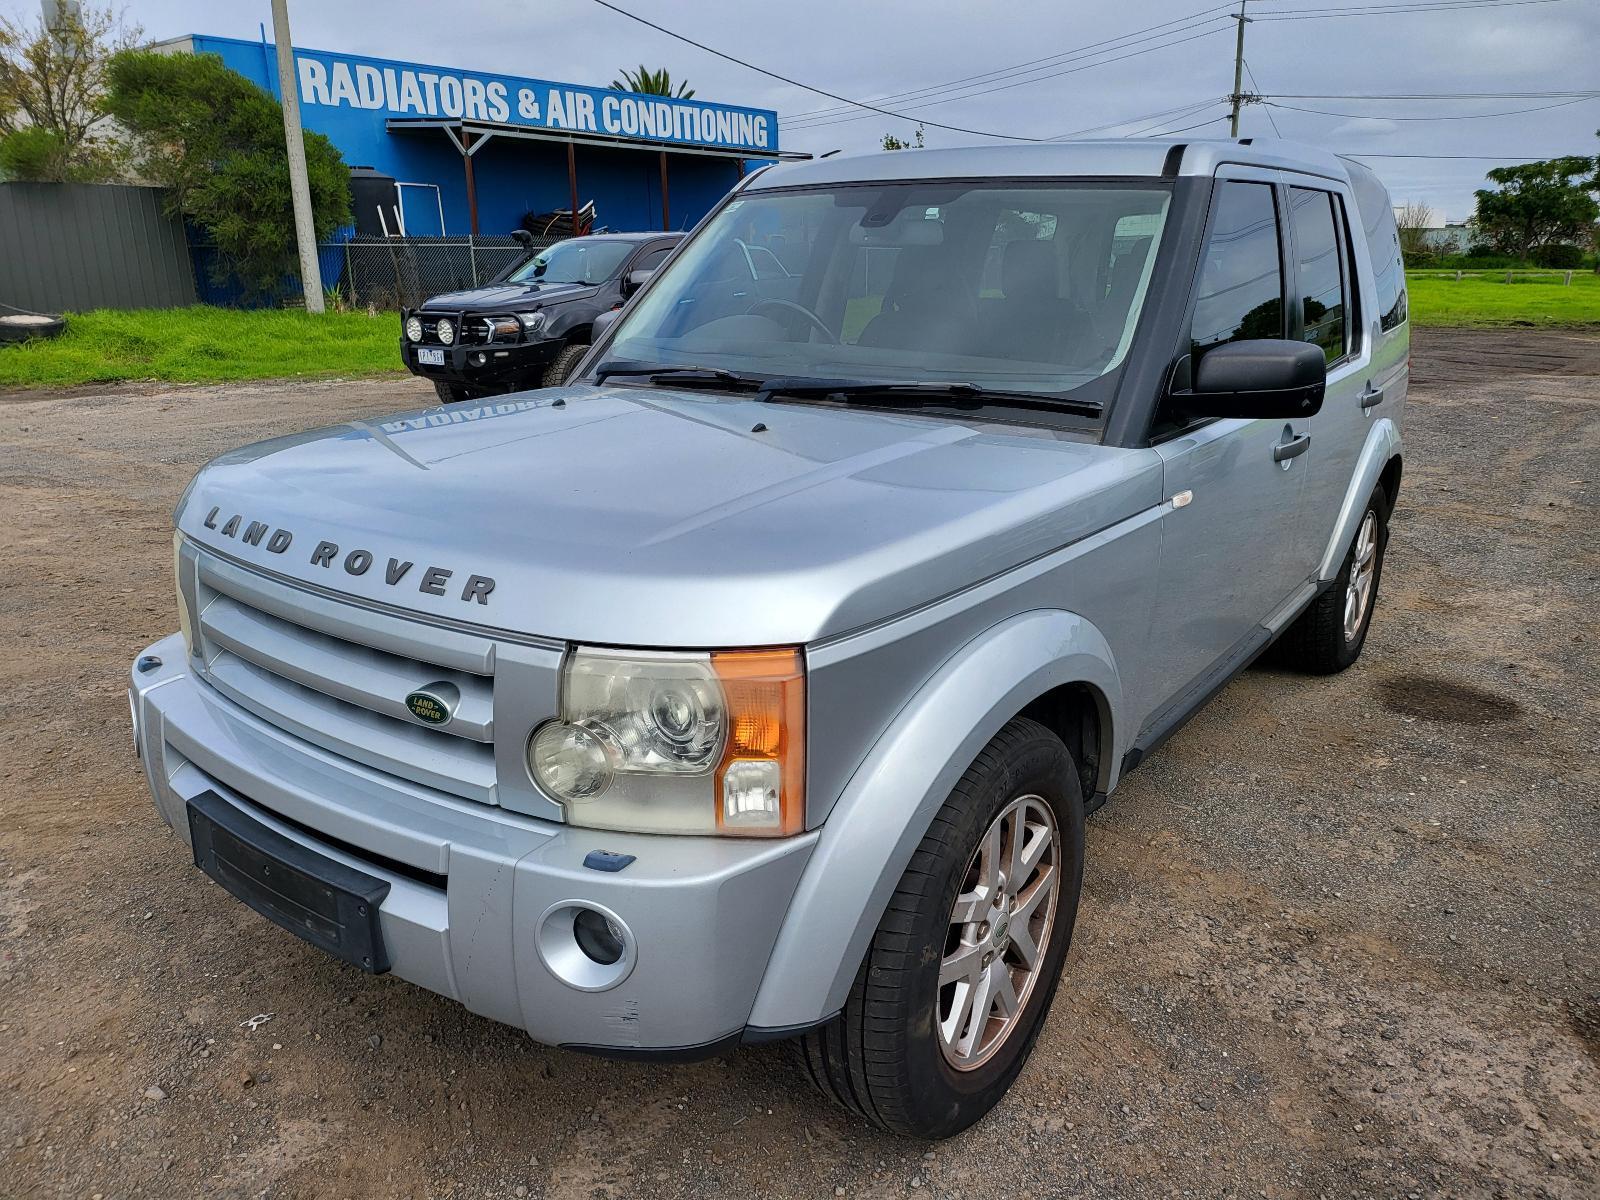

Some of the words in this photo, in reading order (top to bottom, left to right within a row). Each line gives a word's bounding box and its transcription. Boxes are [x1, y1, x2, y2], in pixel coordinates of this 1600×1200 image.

[297, 57, 509, 123] RADIATORS
[518, 88, 540, 120] &
[547, 93, 597, 132] AIR
[602, 95, 768, 148] CONDITIONING
[203, 506, 293, 554] LAND
[310, 540, 496, 605] ROVER
